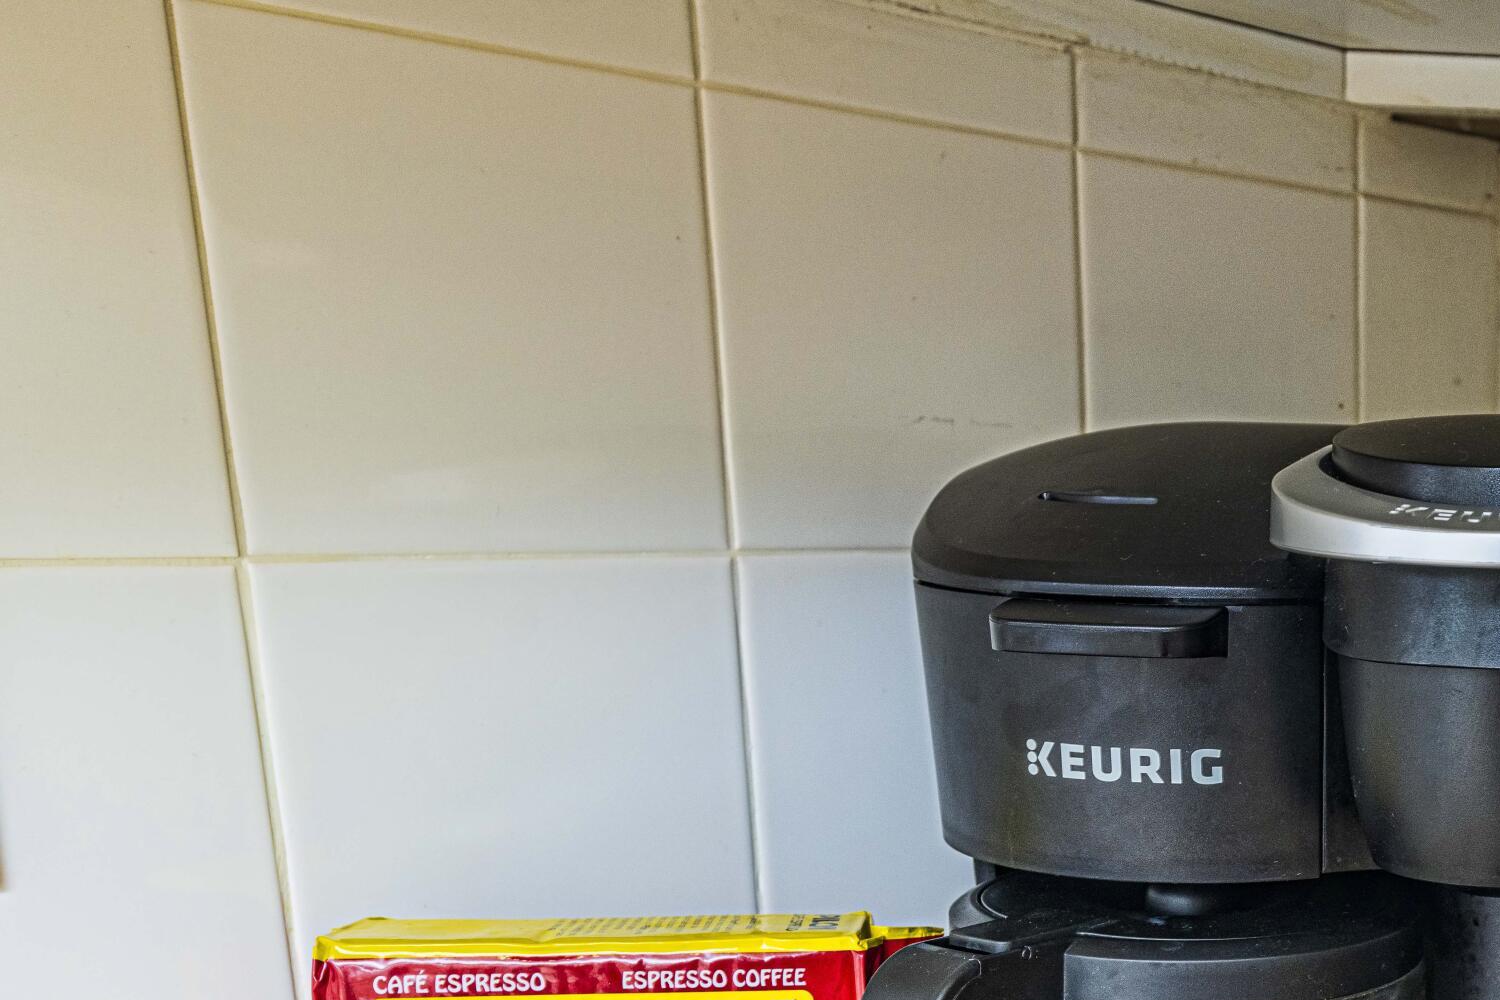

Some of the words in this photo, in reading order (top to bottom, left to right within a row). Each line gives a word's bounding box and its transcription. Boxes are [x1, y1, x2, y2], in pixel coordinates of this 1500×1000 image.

[1025, 737, 1224, 786] KEURIG
[372, 969, 429, 995] CAFÉ
[434, 972, 547, 994] ESPRESSO
[621, 969, 728, 990] ESPRESSO
[732, 967, 807, 988] COFFEE
